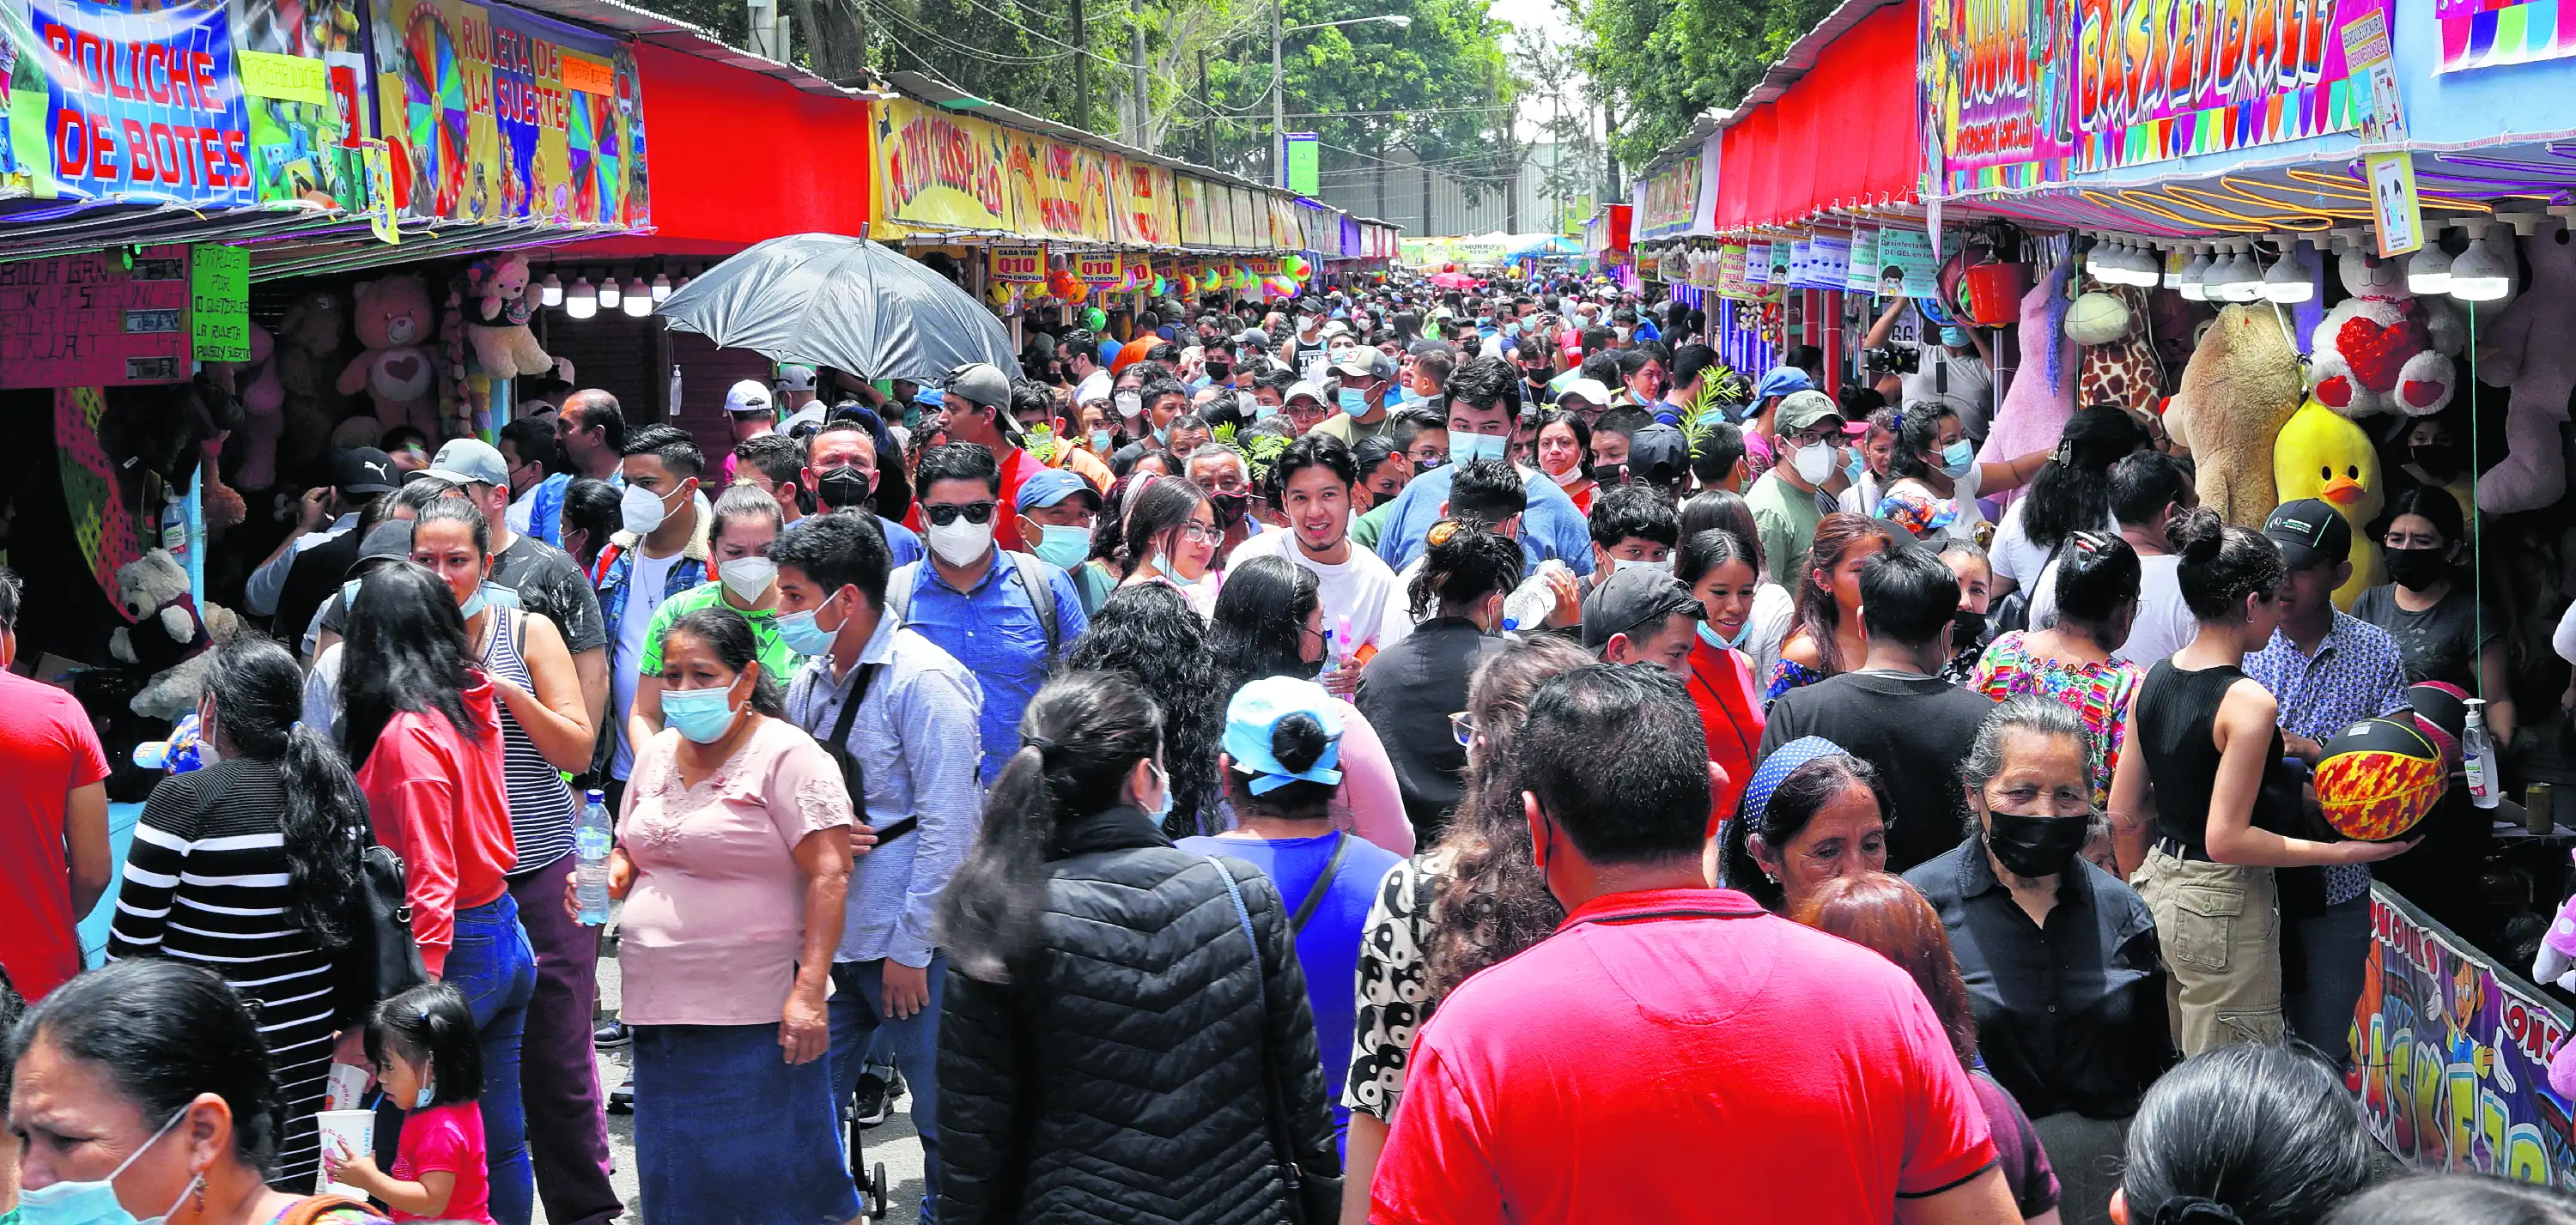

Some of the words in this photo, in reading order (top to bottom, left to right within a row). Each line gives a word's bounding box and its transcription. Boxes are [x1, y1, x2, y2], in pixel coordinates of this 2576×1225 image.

[461, 15, 533, 78] RULETA
[536, 37, 561, 83] DE
[45, 23, 226, 113] BOLICHE
[471, 70, 494, 118] LA
[498, 77, 568, 132] SUERTE
[55, 108, 120, 184] DE
[122, 118, 254, 191] BOTES
[1881, 240, 1929, 250] Desinfectate
[194, 248, 202, 267] 3
[998, 258, 1036, 274] Q10
[0, 260, 58, 286] BOLA
[1082, 262, 1114, 275] Q10
[1722, 272, 1744, 281] FRESAS
[211, 274, 231, 293] POR
[197, 324, 207, 337] LA
[1806, 396, 1828, 409] CAT
